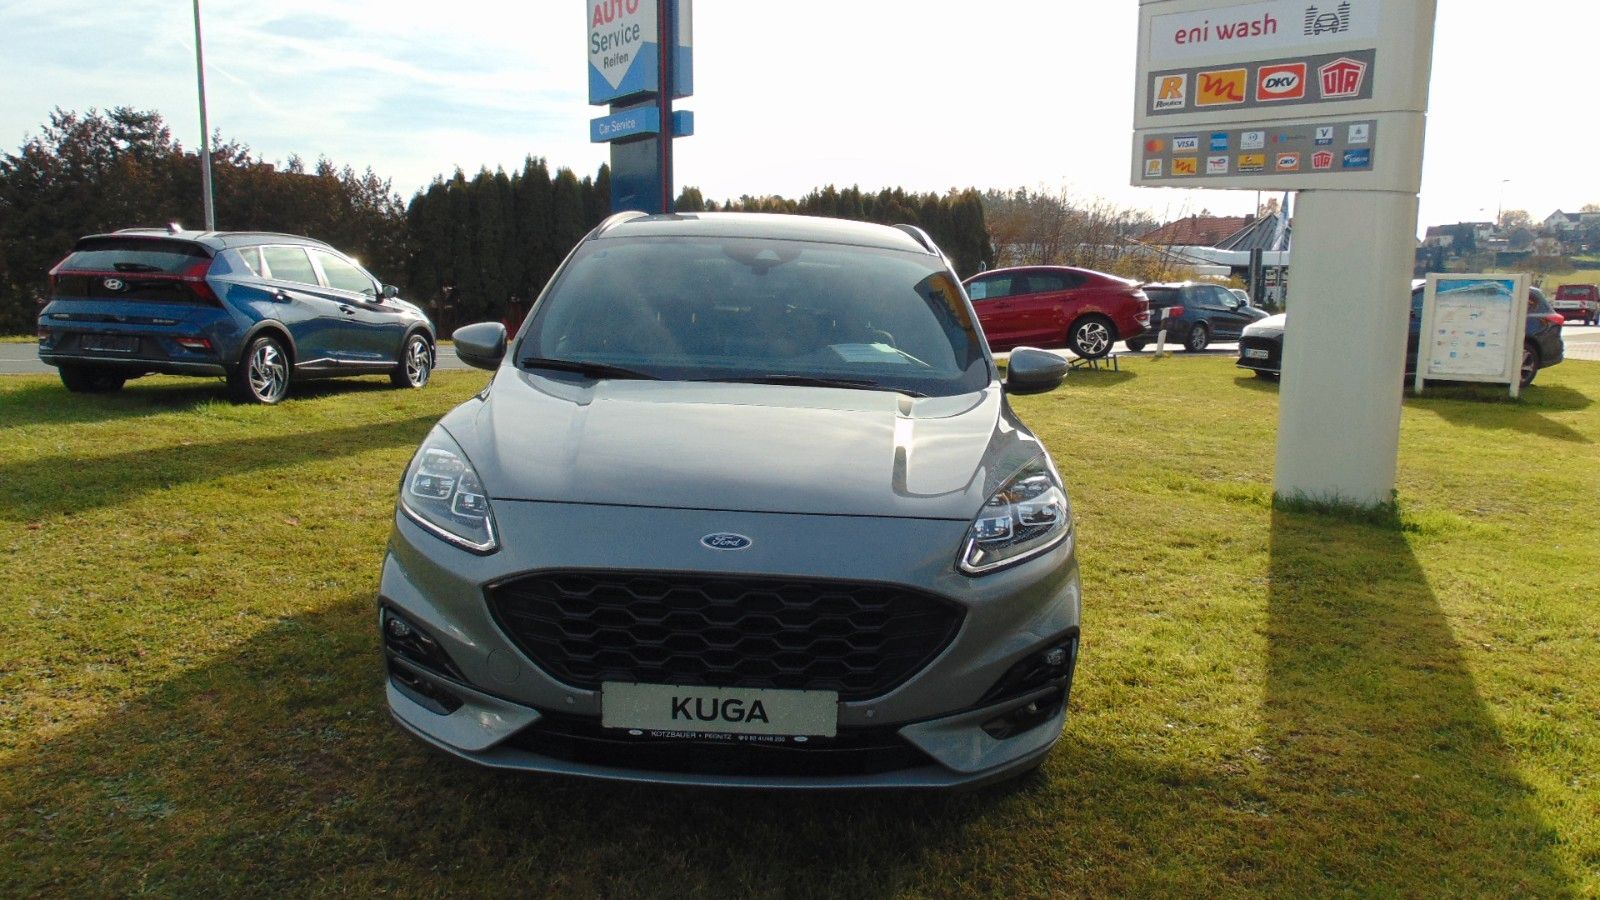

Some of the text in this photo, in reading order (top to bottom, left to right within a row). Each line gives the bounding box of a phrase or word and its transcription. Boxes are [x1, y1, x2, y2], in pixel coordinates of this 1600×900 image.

[592, 0, 640, 27] AUTO
[1175, 13, 1277, 44] eni wash
[591, 22, 641, 54] Service
[603, 52, 629, 69] Reifen
[1265, 76, 1296, 88] DKV
[1323, 62, 1361, 96] UTA
[599, 118, 636, 135] Car Service
[1177, 140, 1195, 148] VISA
[1279, 157, 1297, 165] DKV
[712, 536, 741, 546] Ford
[671, 696, 769, 724] KUGA
